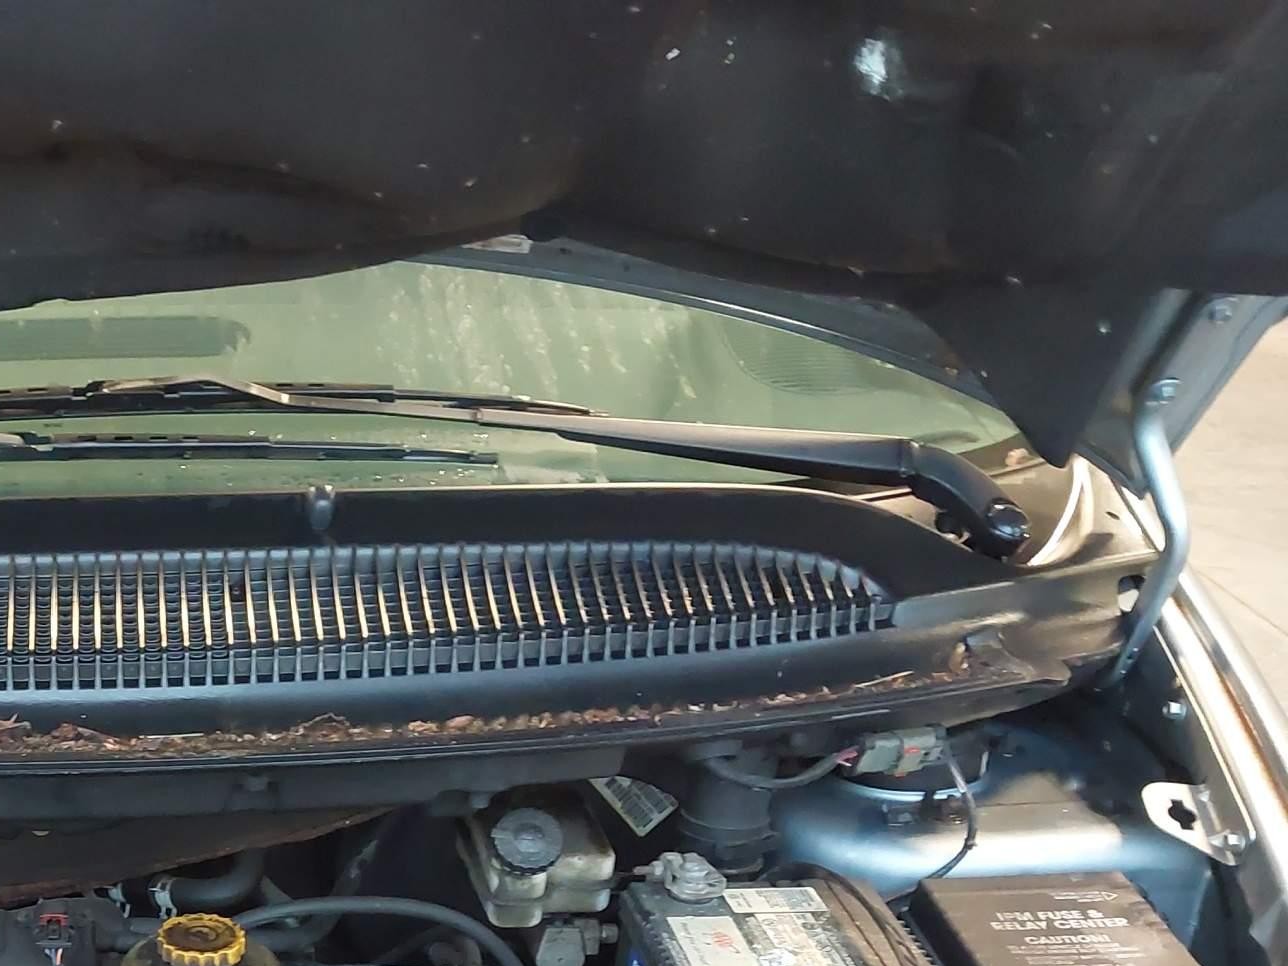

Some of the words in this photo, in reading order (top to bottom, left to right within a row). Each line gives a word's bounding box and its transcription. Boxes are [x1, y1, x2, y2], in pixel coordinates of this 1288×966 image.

[1037, 910, 1085, 920] FUSE
[1086, 909, 1104, 919] &
[990, 921, 1048, 931] RELAY
[1054, 917, 1130, 929] CENTER
[1024, 934, 1112, 945] CAUTION!
